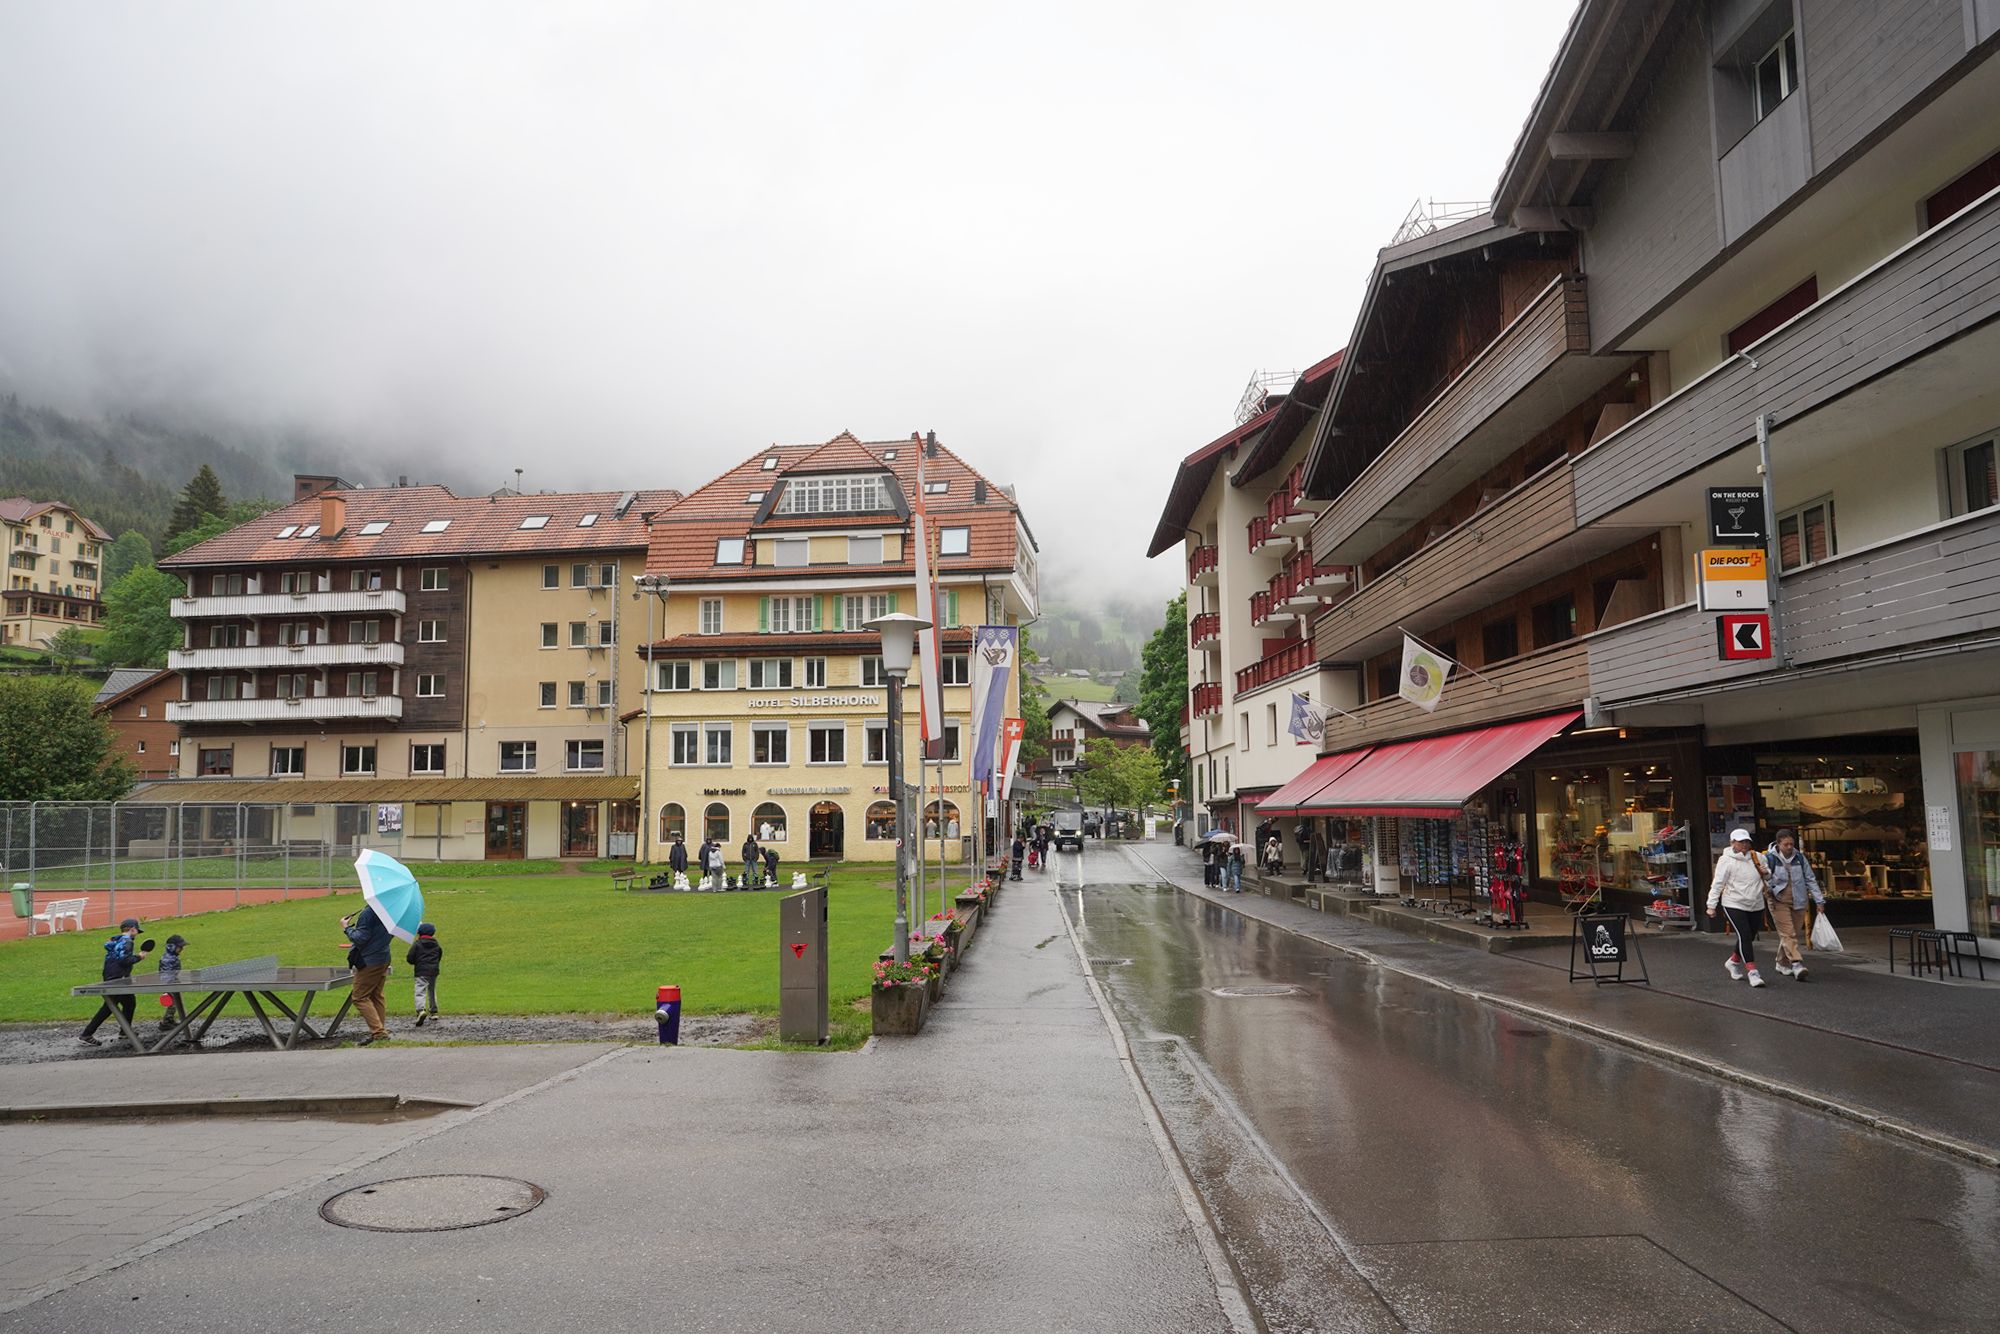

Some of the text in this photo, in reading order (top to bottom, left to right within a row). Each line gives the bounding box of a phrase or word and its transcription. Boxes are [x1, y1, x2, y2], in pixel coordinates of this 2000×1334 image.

[43, 528, 70, 538] FALKEN
[1710, 556, 1750, 565] DIE POST
[748, 695, 880, 708] HOTEL SILBERHORN
[704, 788, 746, 796] Hair Studio
[1592, 944, 1618, 954] toGo
